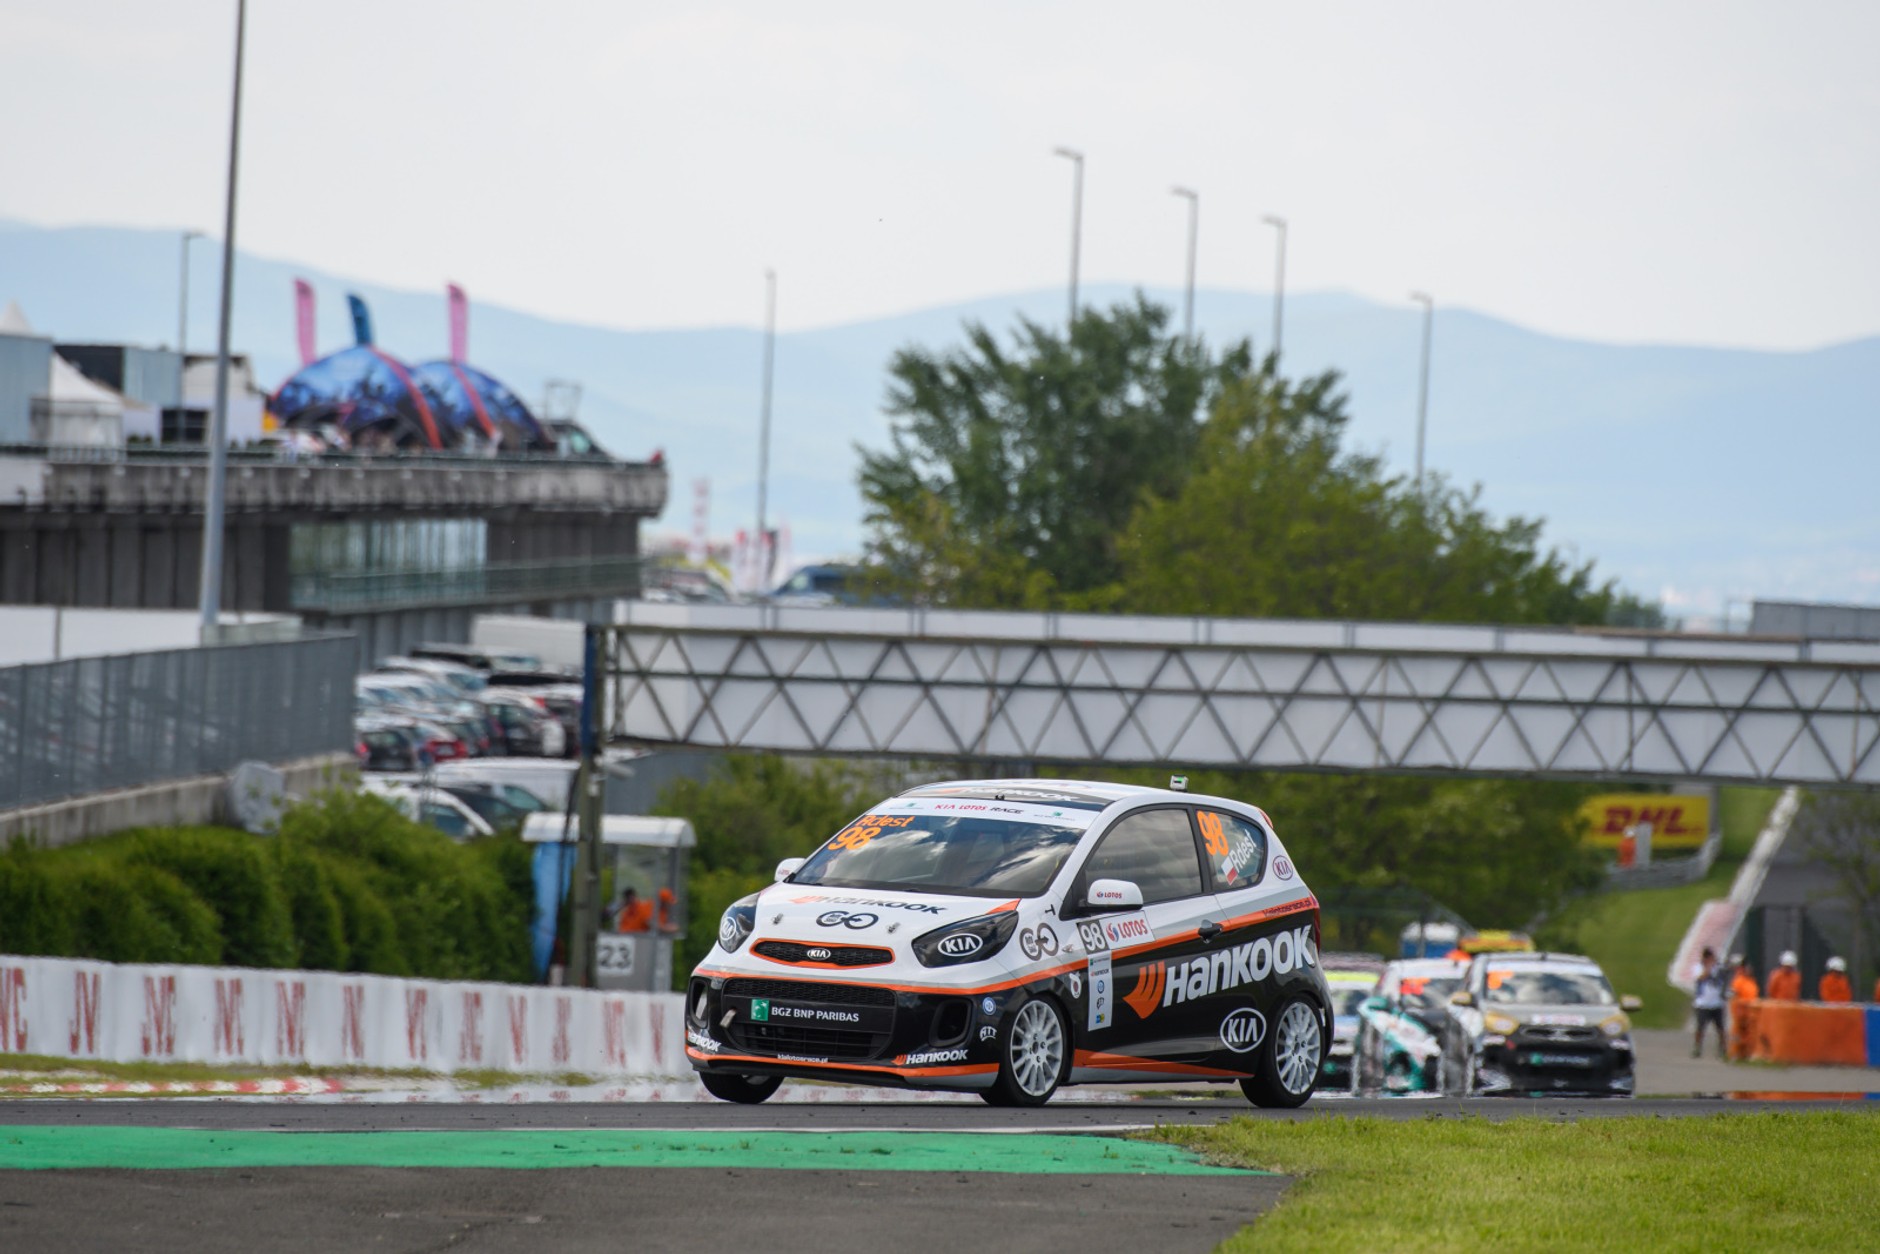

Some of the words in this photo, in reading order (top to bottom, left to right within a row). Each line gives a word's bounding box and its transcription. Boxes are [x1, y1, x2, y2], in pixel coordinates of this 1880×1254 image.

[934, 803, 956, 811] KIA
[990, 806, 1024, 815] RACE
[1603, 805, 1687, 835] DHL
[855, 815, 916, 828] Rdest
[828, 826, 882, 851] 98
[1197, 809, 1229, 857] 98
[1229, 829, 1257, 874] Rdest
[1274, 860, 1291, 877] KIA
[1080, 922, 1107, 952] 98
[1117, 918, 1149, 939] LOTOS
[811, 949, 828, 958] KIA
[944, 936, 977, 954] KIA
[598, 945, 631, 969] 23
[794, 1008, 815, 1020] BNP
[817, 1010, 859, 1022] PARIBAS
[1228, 1017, 1258, 1044] KIA
